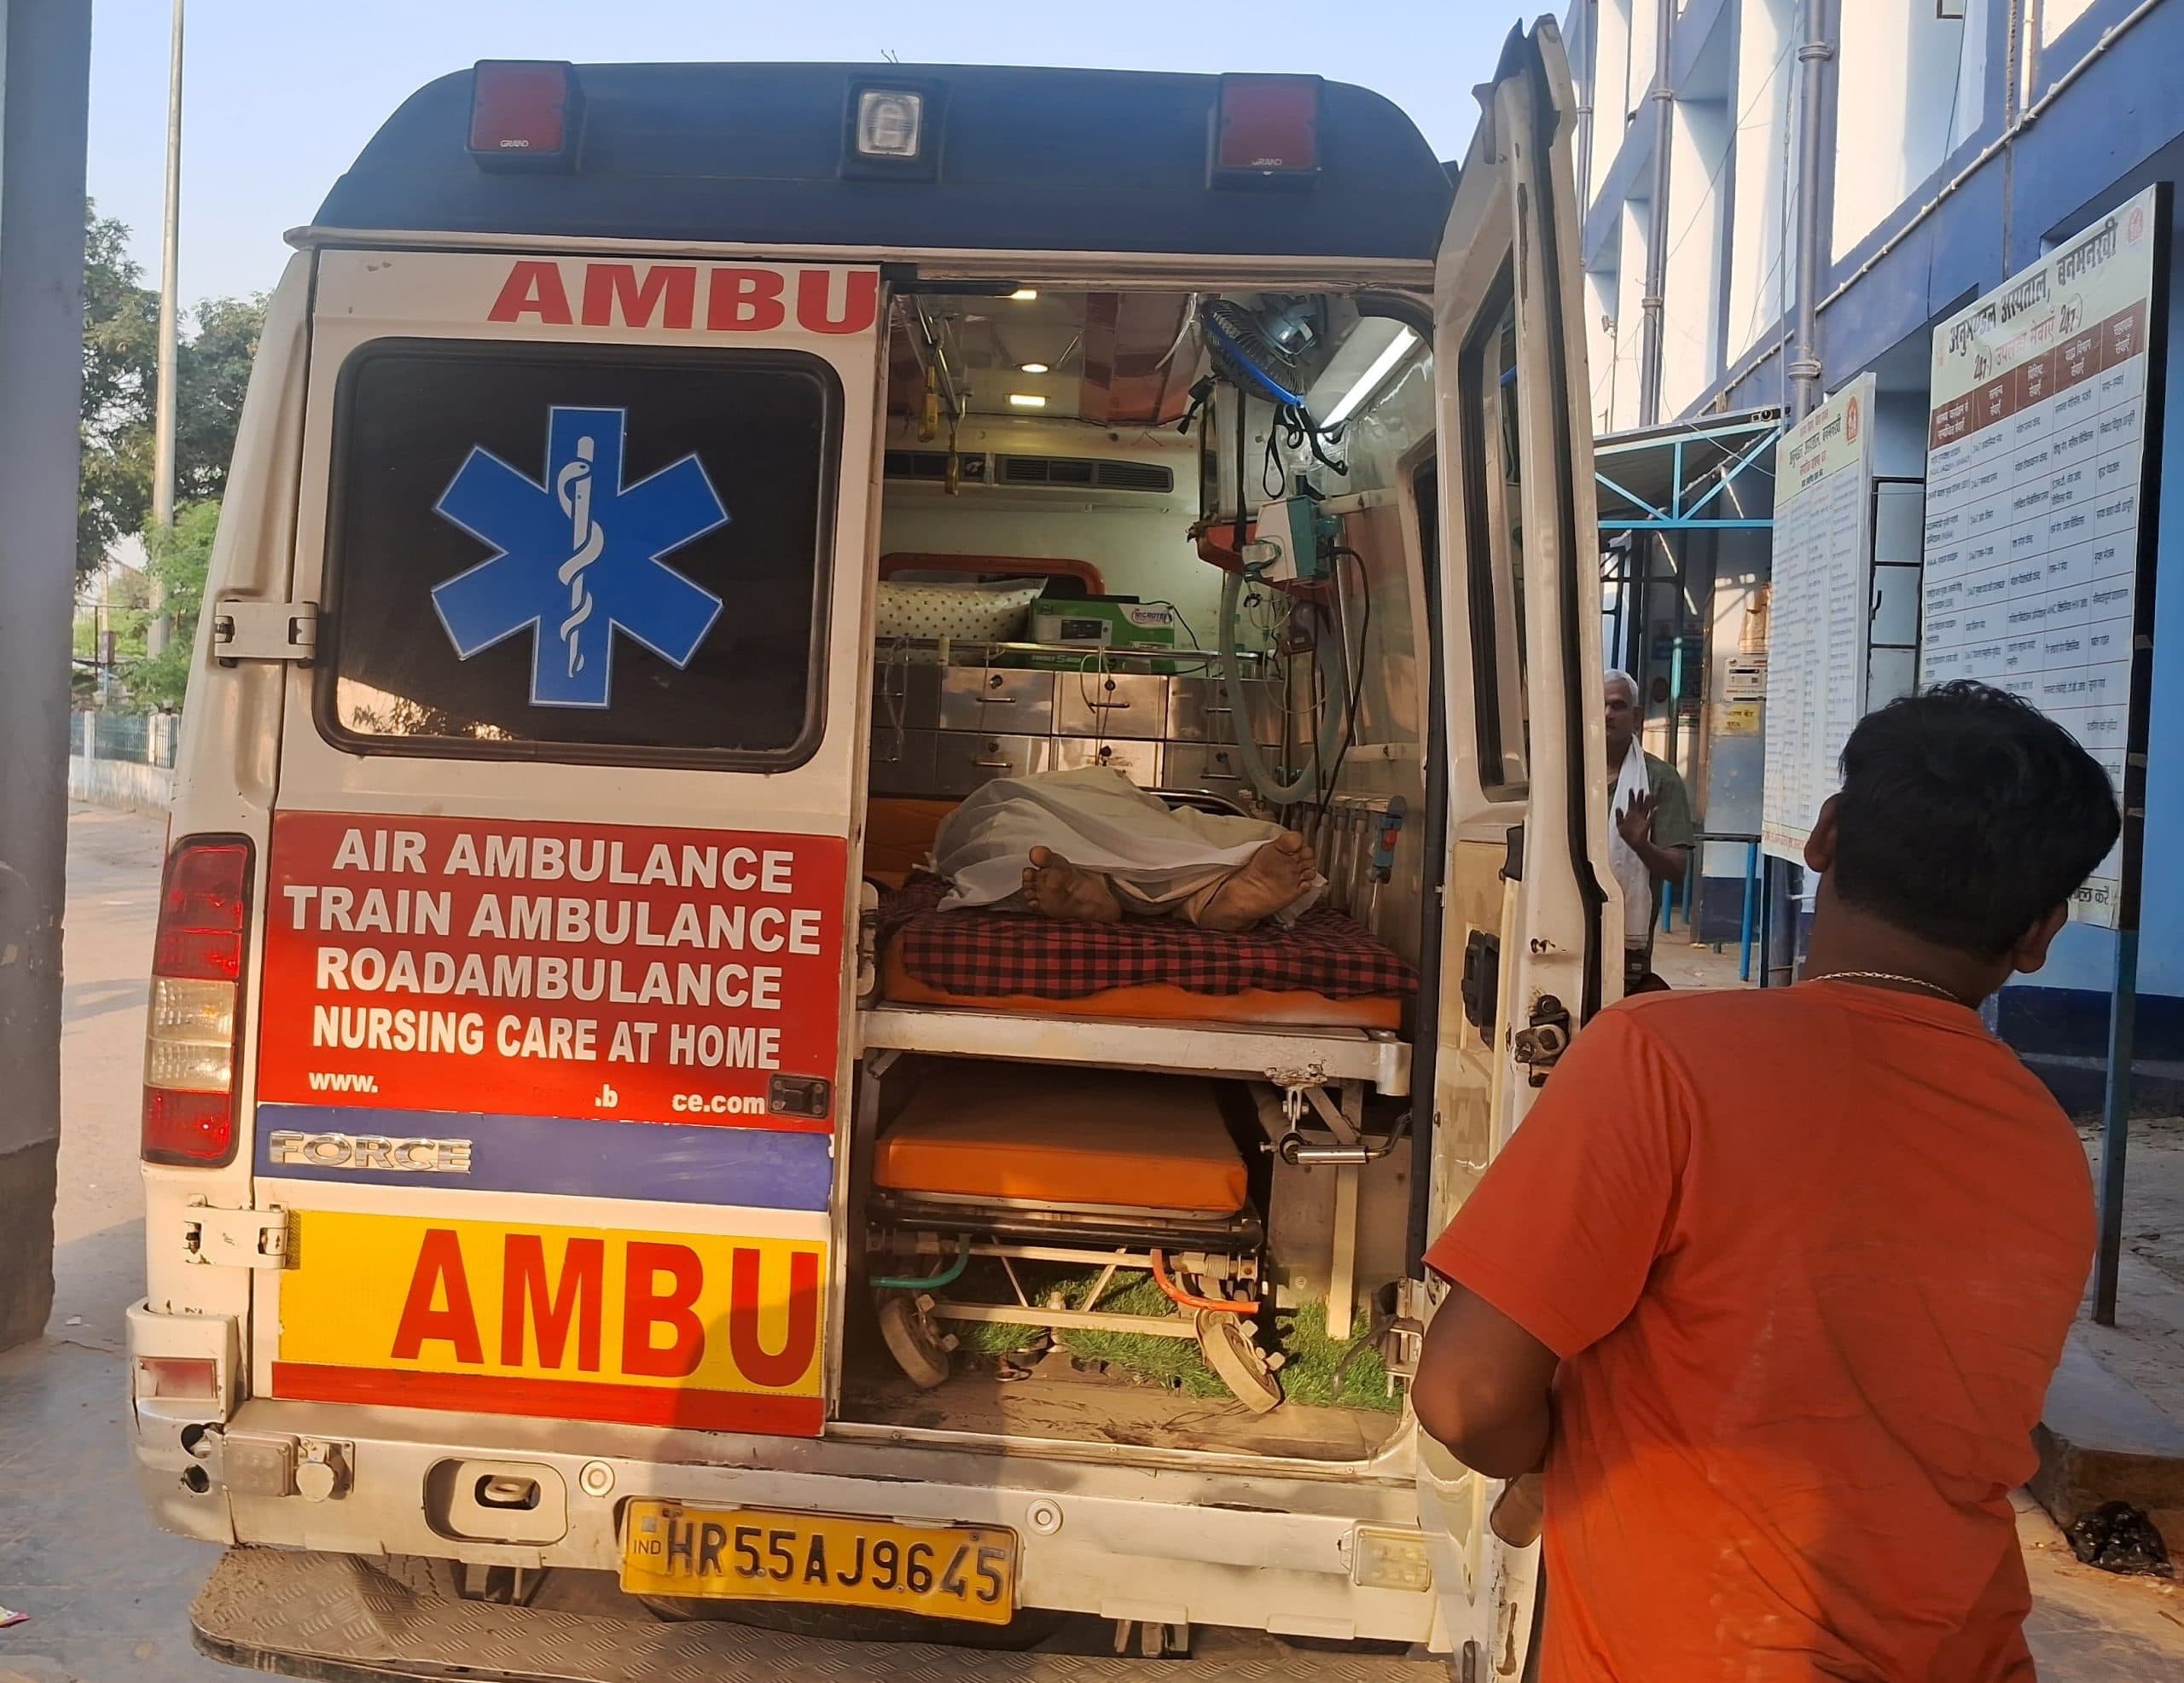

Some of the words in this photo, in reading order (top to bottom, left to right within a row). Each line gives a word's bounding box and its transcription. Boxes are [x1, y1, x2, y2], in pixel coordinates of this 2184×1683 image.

[486, 260, 879, 335] AMBU
[333, 827, 427, 875] AIR
[444, 833, 795, 894] AMBULANCE
[283, 885, 452, 937] TRAIN
[468, 893, 823, 955] AMBULANCE
[316, 947, 783, 1010] ROADAMBULANCE
[312, 1006, 485, 1055] NURSING
[497, 1015, 597, 1062] CARE
[608, 1021, 658, 1064] AT
[669, 1024, 781, 1071] HOME
[671, 1094, 766, 1115] ce.com
[269, 1129, 473, 1175] FORCE
[391, 1228, 819, 1389] AMBU
[632, 1540, 663, 1557] IND
[666, 1516, 1007, 1604] HR55AJ9645
